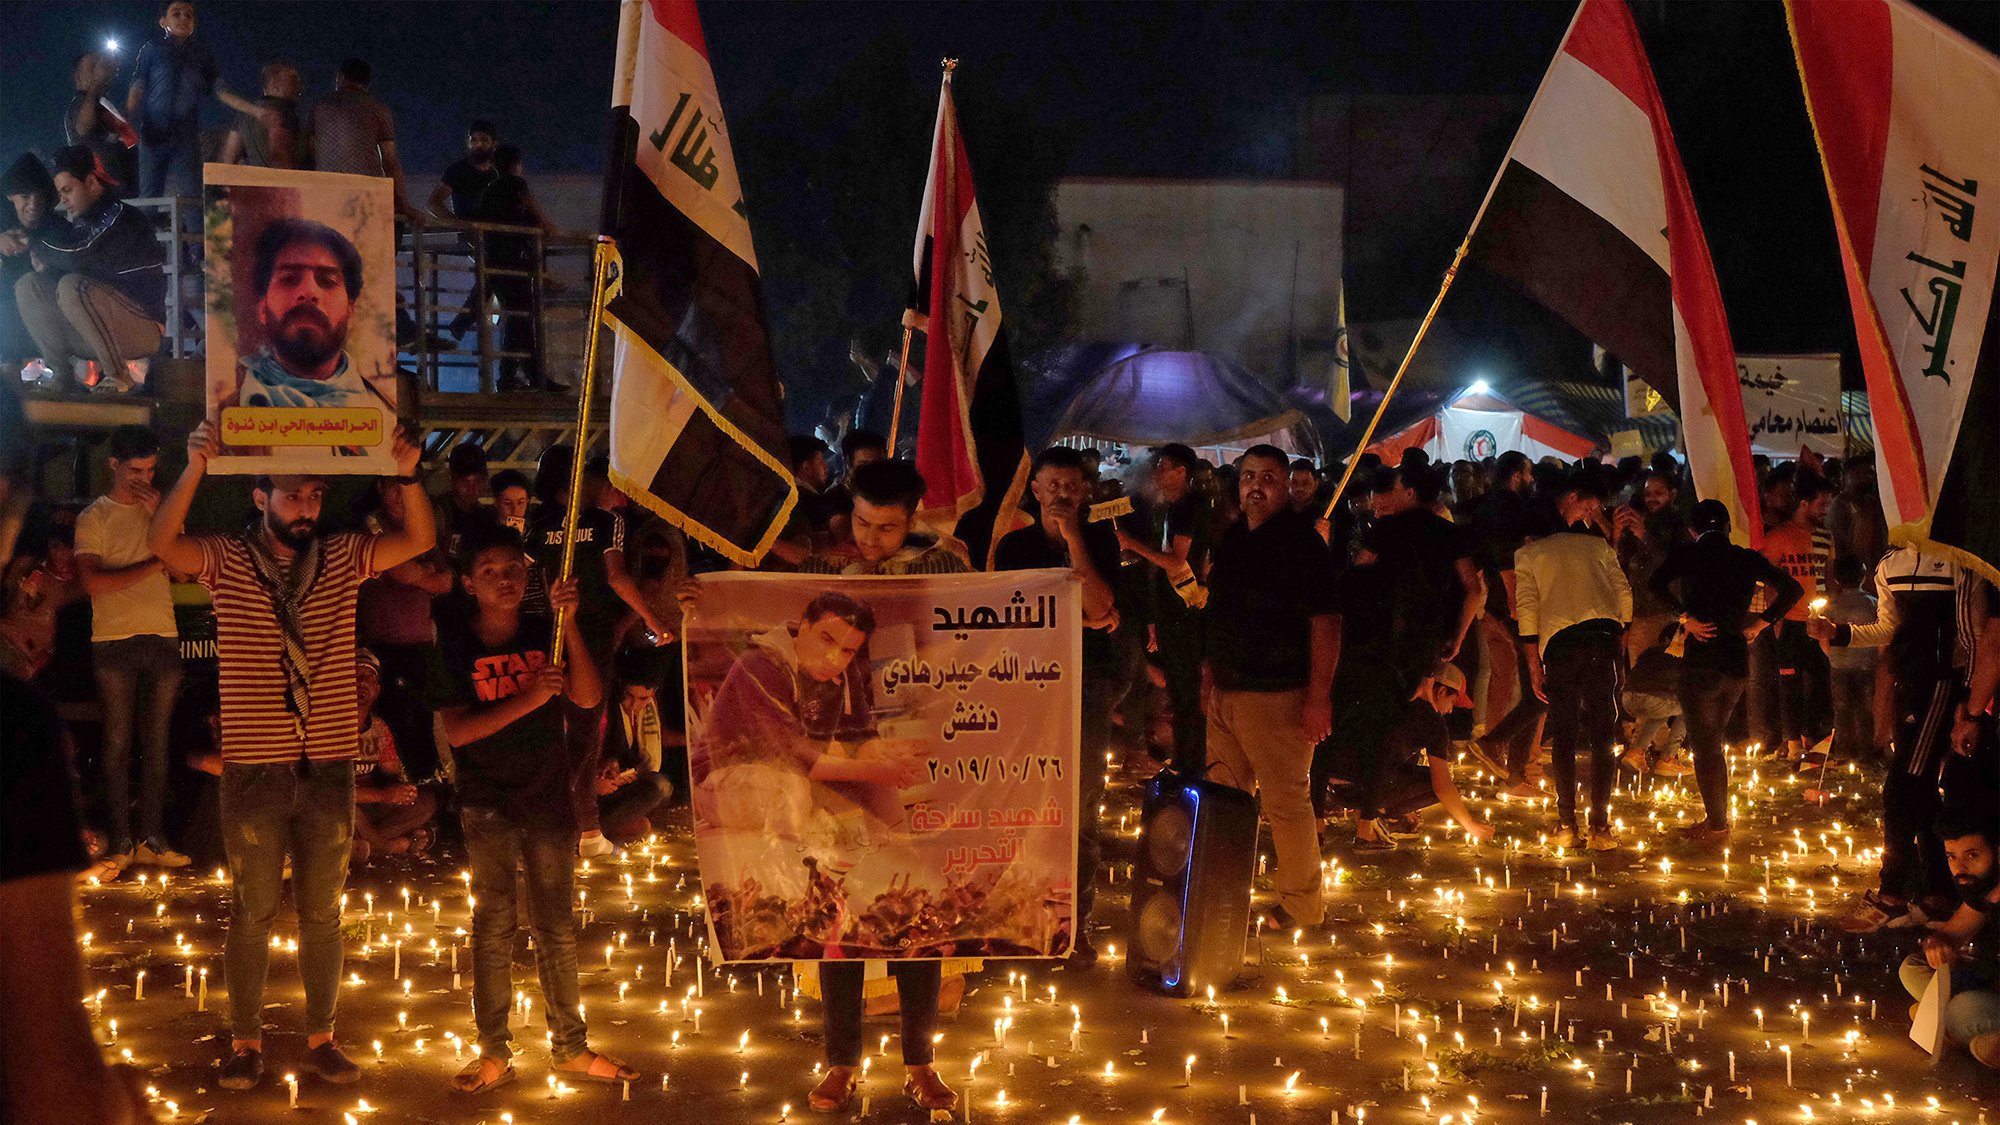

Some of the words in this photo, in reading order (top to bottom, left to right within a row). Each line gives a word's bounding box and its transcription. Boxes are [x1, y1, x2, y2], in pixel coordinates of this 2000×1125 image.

[1912, 163, 1978, 242] الله
[258, 418, 278, 434] ابن
[280, 418, 305, 437] الحي
[306, 419, 348, 434] العظيم
[348, 419, 377, 433] الحر
[932, 590, 1056, 641] الشهيد
[472, 651, 546, 680] STAR
[883, 656, 931, 694] هادي
[933, 659, 982, 690] حيدر
[987, 650, 1019, 682] الله
[1024, 659, 1061, 689] عبد
[943, 701, 999, 740] دنفش
[912, 803, 981, 831] ساحة
[988, 796, 1063, 835] شهيد
[941, 835, 1025, 875] التحرير
